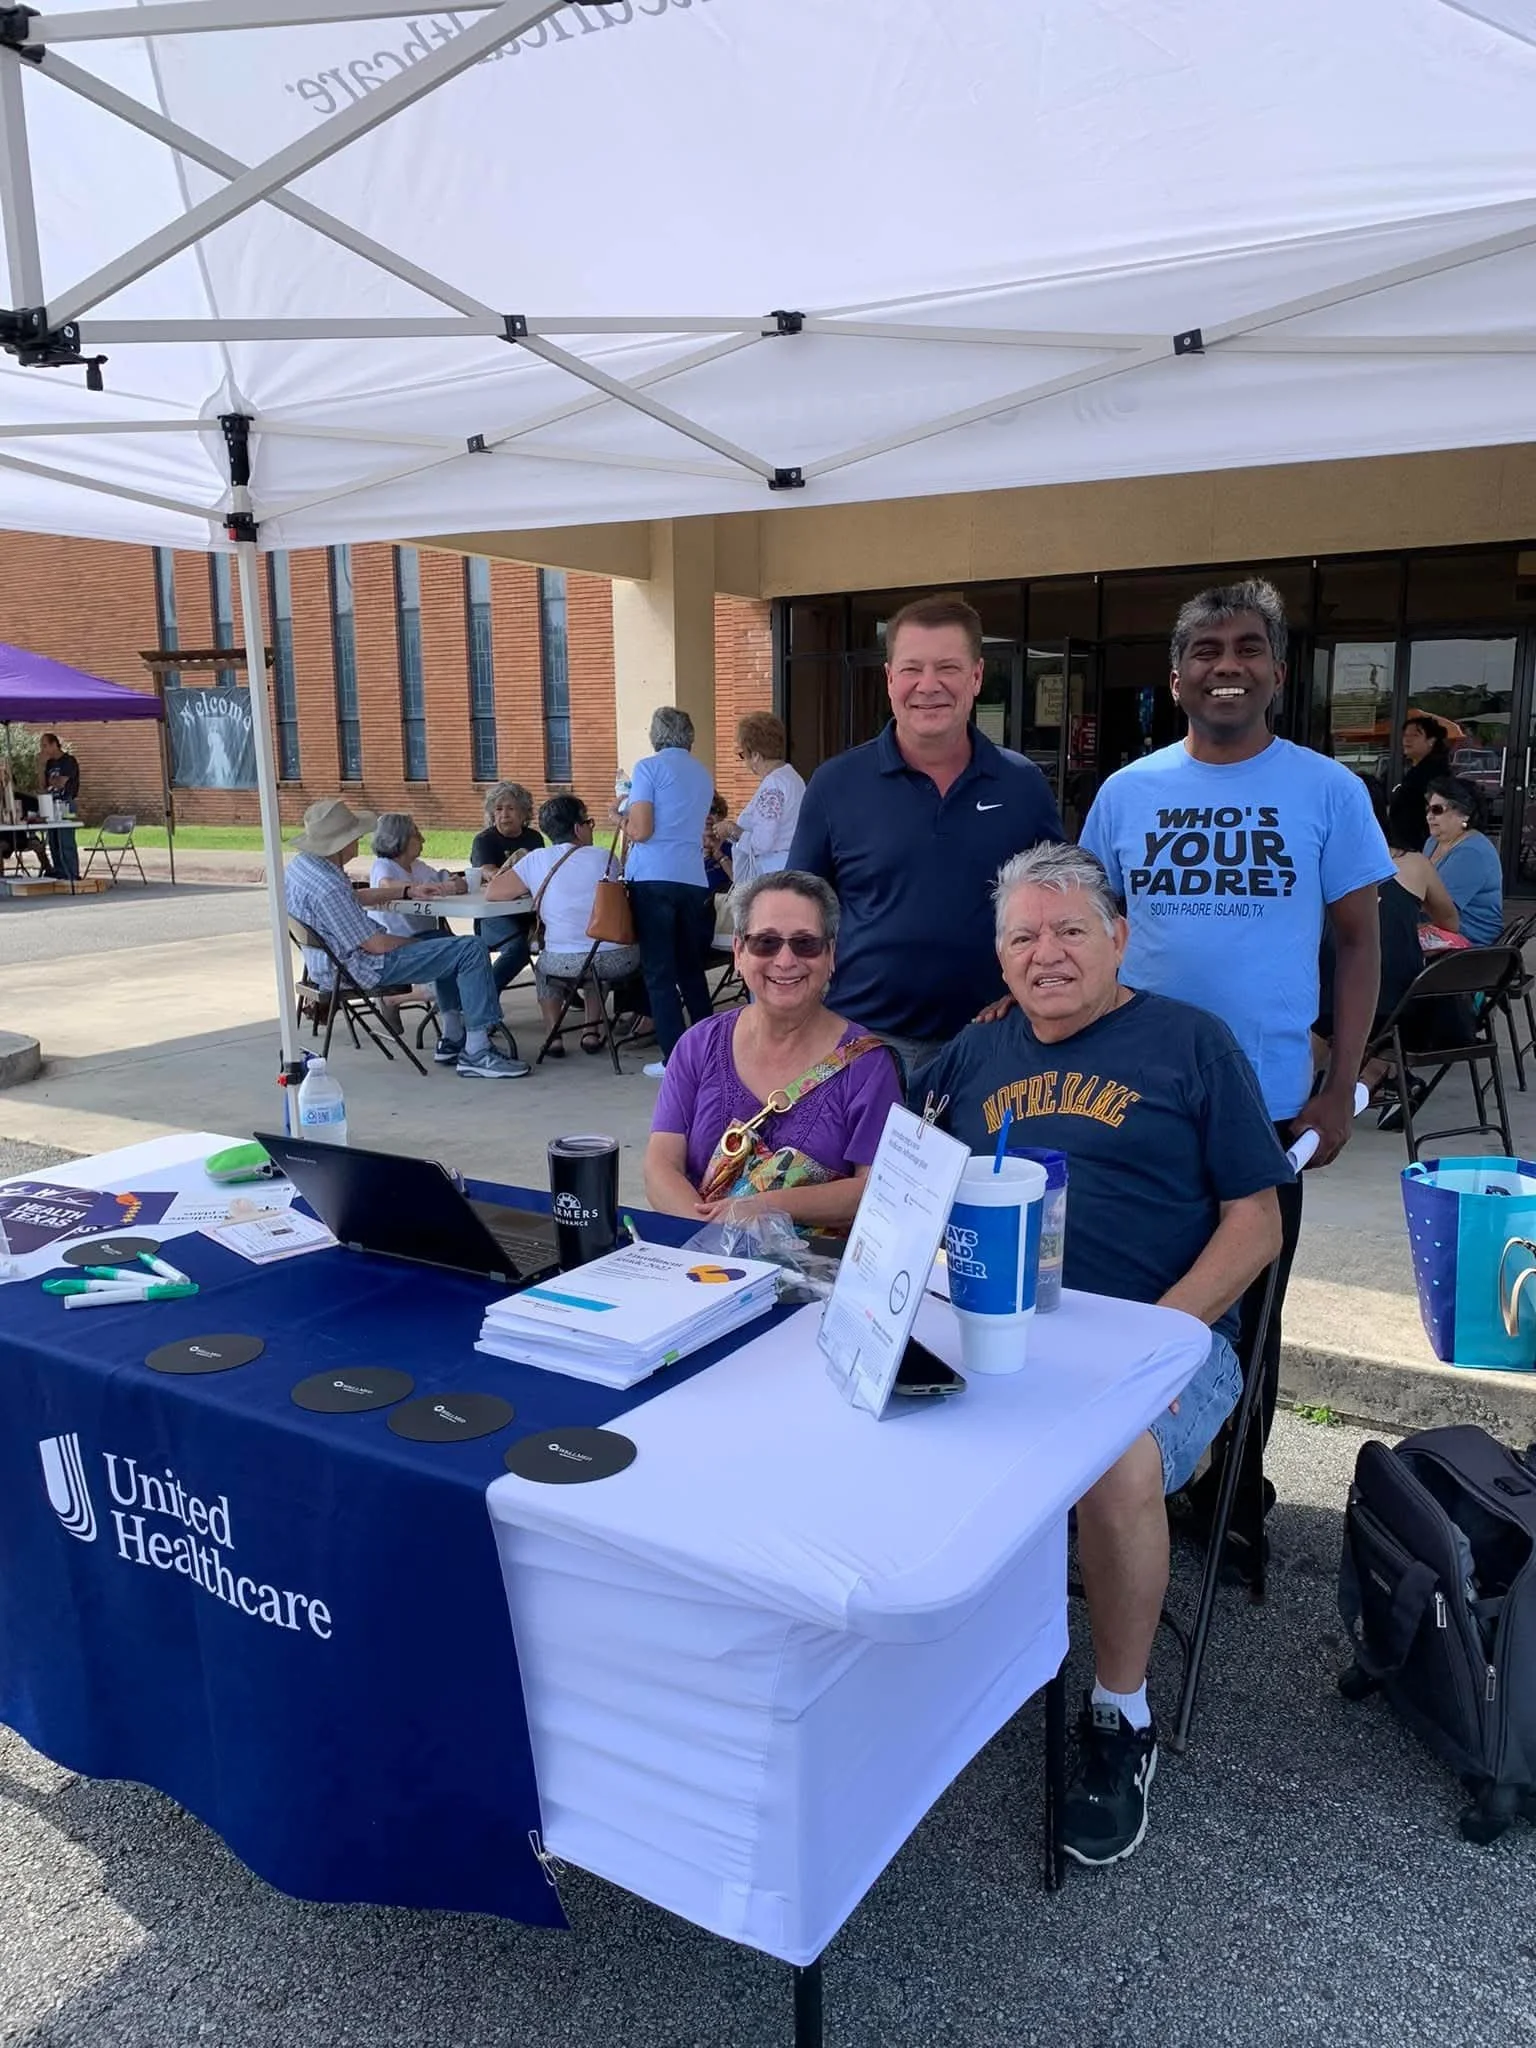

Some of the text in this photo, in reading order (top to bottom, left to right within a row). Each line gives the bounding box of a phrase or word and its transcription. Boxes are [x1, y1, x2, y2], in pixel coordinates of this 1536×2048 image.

[180, 692, 252, 732] Welcome
[1156, 807, 1279, 829] WHO'S
[1143, 831, 1293, 868] YOUR
[1130, 868, 1297, 897] PADRE?
[1151, 903, 1178, 916] SOUTH
[1181, 903, 1211, 917] PADRE
[983, 1072, 1142, 1134] NOTRE DAME
[5, 1210, 73, 1228] TEXAS
[15, 1202, 87, 1220] HEALTH
[553, 1205, 599, 1219] RMERS
[948, 1225, 977, 1246] AYS
[946, 1240, 972, 1259] OLD
[950, 1257, 986, 1278] GER
[102, 1452, 235, 1550] United
[110, 1509, 333, 1640] Healthcare
